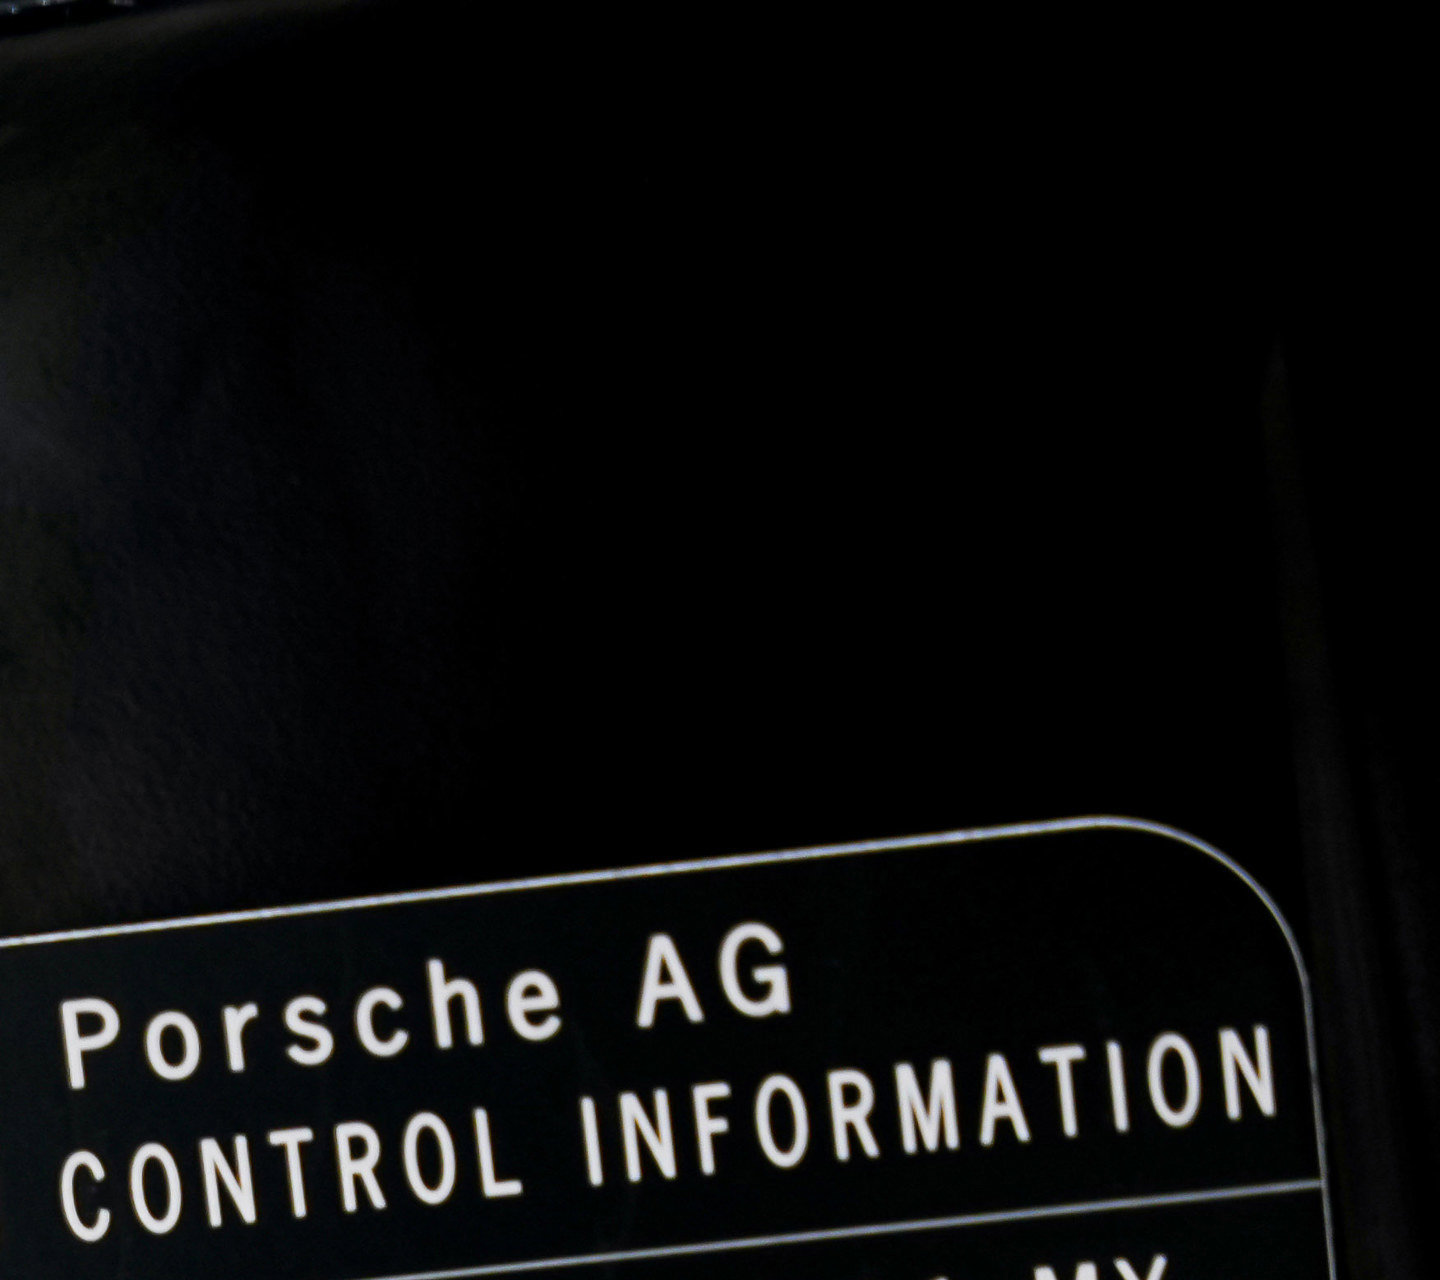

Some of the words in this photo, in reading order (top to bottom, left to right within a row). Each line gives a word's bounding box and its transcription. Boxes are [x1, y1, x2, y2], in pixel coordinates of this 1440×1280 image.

[58, 957, 563, 1092] Porsche
[635, 921, 792, 1030] AG
[58, 1106, 525, 1244] CONTROL
[578, 1024, 1277, 1188] INFORMATION
